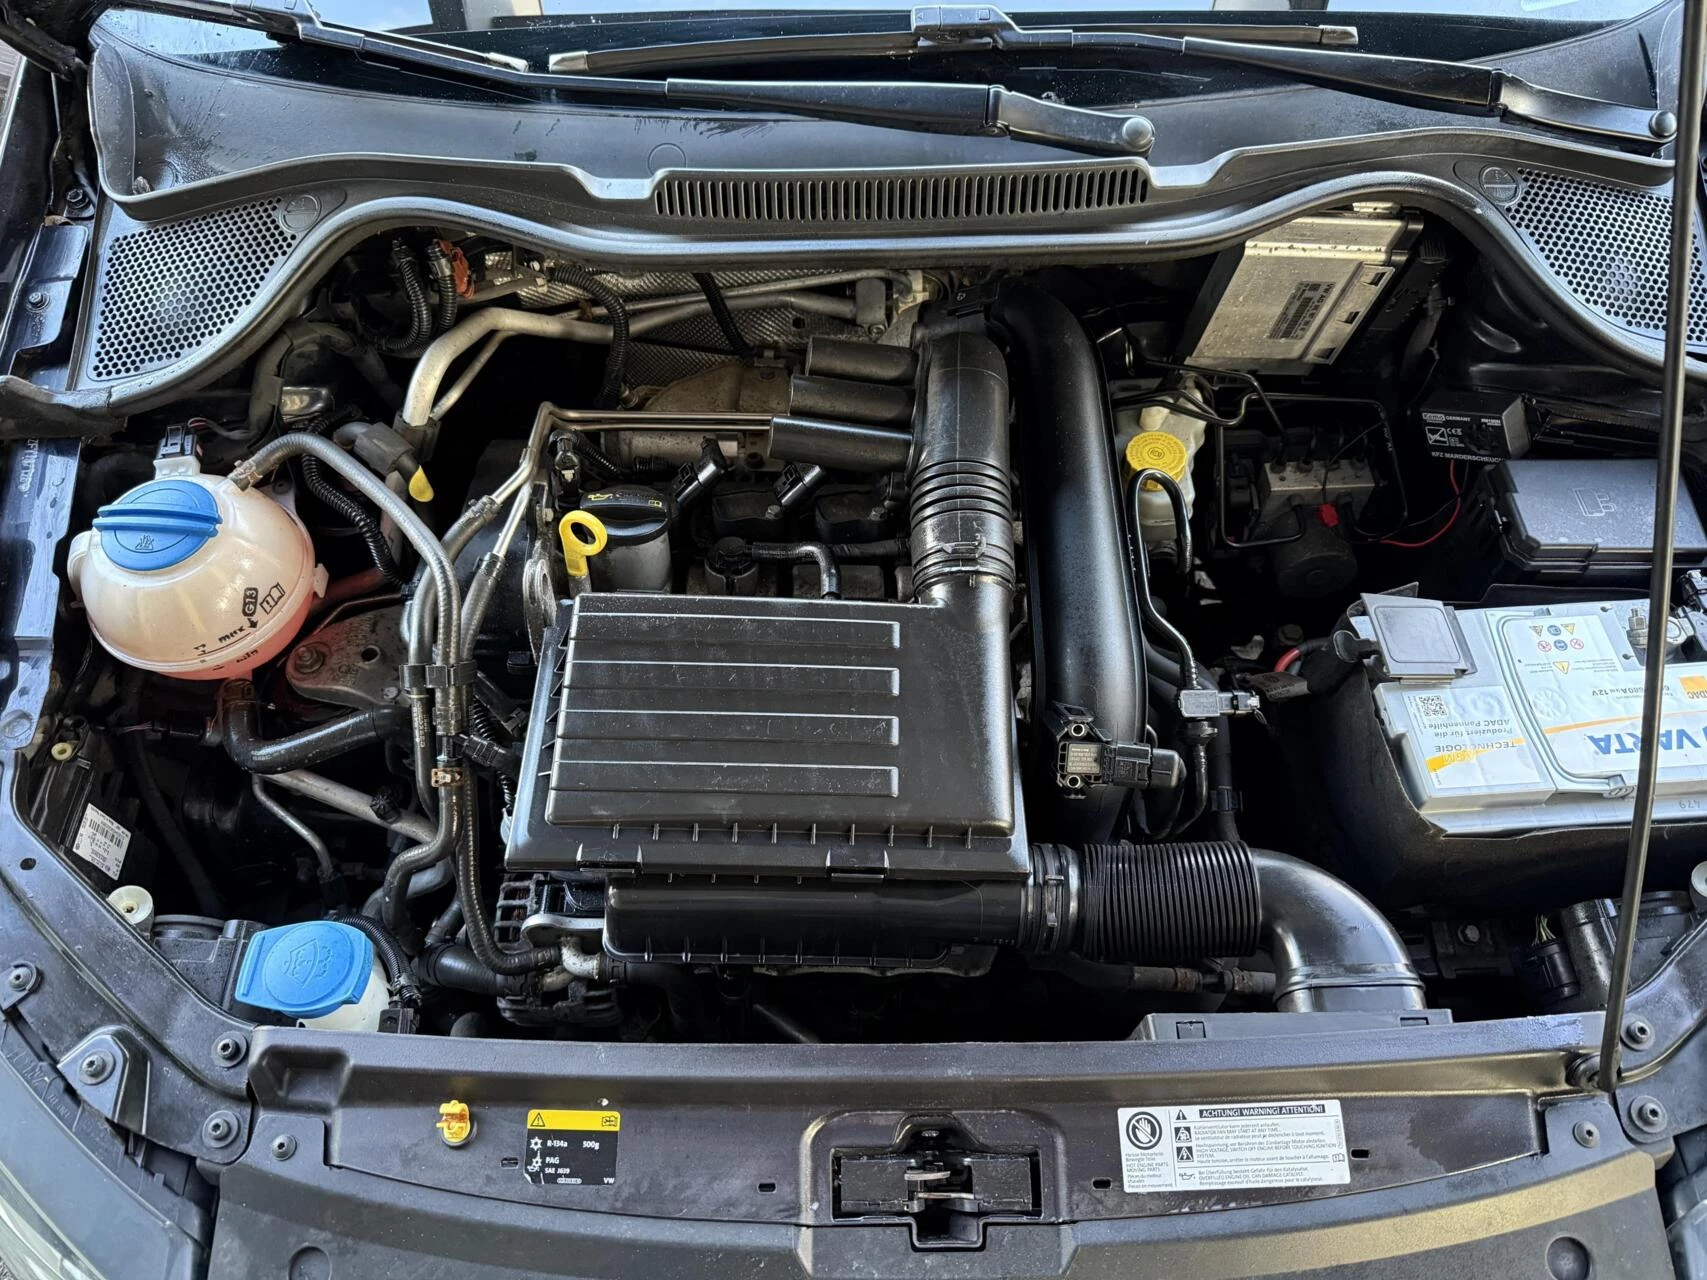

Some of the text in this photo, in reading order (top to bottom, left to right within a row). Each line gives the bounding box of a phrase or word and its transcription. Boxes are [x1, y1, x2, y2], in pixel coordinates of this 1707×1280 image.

[244, 589, 257, 614] G13
[1428, 719, 1510, 731] ADAC Pannenhilfe
[1466, 728, 1512, 736] Produziert
[1434, 741, 1516, 753] TECHNOLOGIE
[1202, 1104, 1324, 1118] ACHTUNG! WARNING! ATTENTION!
[546, 1140, 600, 1150] R-134a 500g
